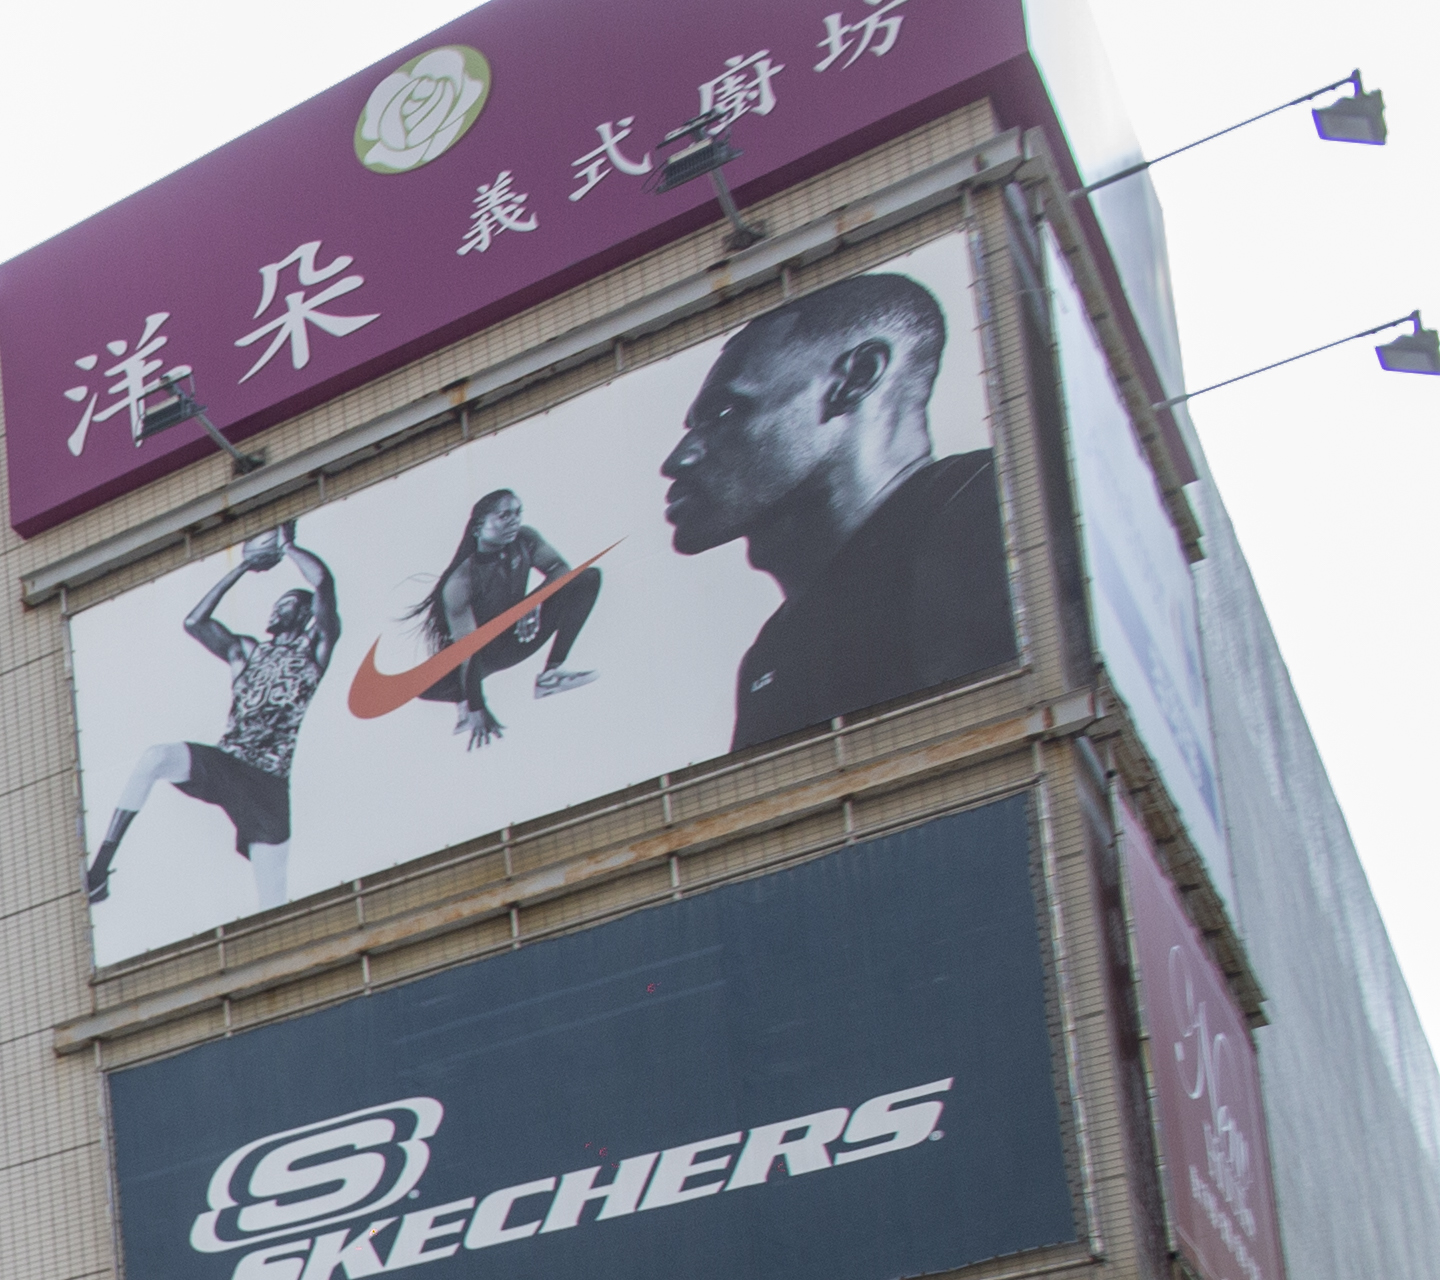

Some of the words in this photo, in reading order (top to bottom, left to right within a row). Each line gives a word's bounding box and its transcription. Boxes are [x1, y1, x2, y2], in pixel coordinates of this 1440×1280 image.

[63, 238, 380, 458] 洋朵
[457, 0, 908, 256] 義式廚坊
